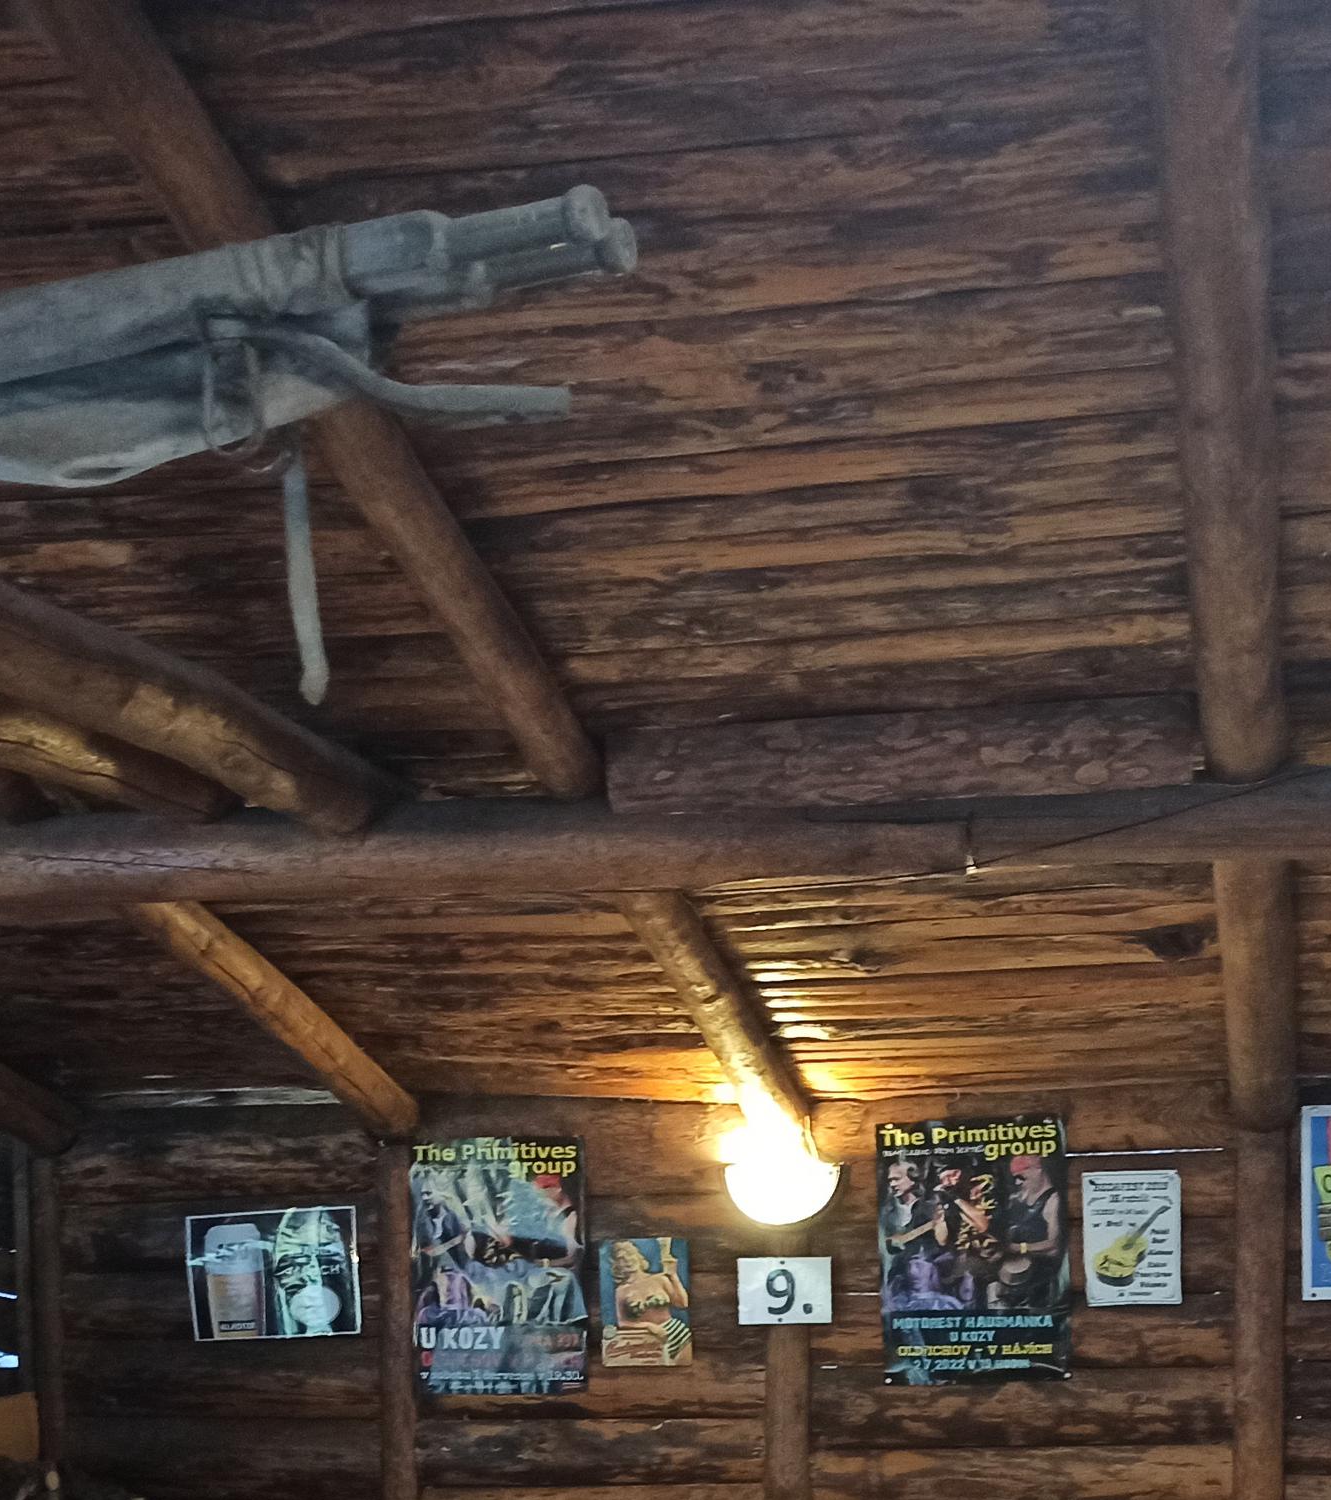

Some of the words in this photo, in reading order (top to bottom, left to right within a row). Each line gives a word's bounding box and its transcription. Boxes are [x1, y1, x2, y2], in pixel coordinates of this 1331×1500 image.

[879, 1126, 925, 1147] The
[931, 1122, 1057, 1145] Primitives
[413, 1144, 456, 1161] The
[461, 1141, 577, 1161] Primitives
[983, 1139, 1057, 1162] group
[508, 1159, 577, 1181] group
[765, 1268, 814, 1316] 9.
[419, 1326, 437, 1350] U
[442, 1326, 506, 1350] KOZY
